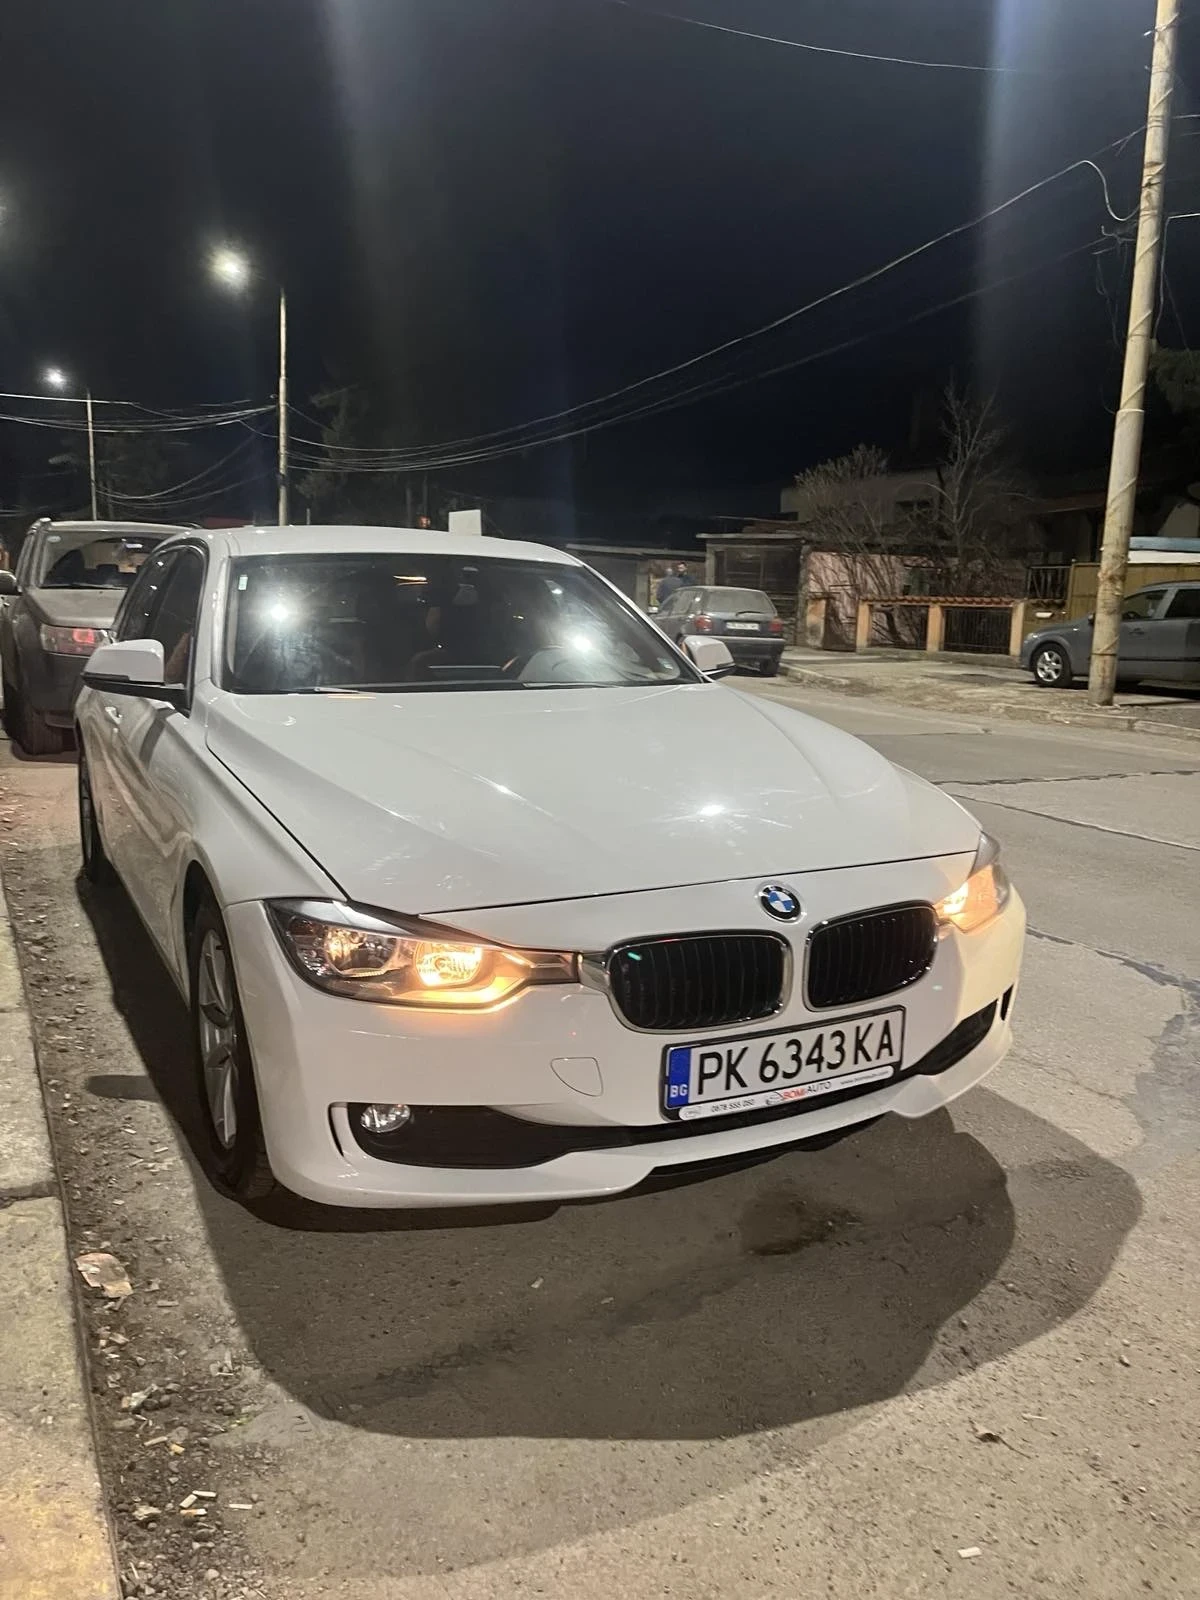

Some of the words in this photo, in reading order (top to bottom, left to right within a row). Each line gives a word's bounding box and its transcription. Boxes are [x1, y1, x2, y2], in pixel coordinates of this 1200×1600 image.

[698, 1047, 749, 1095] PK
[759, 1030, 846, 1083] 6343
[853, 1020, 894, 1065] KA
[670, 1084, 688, 1098] BG
